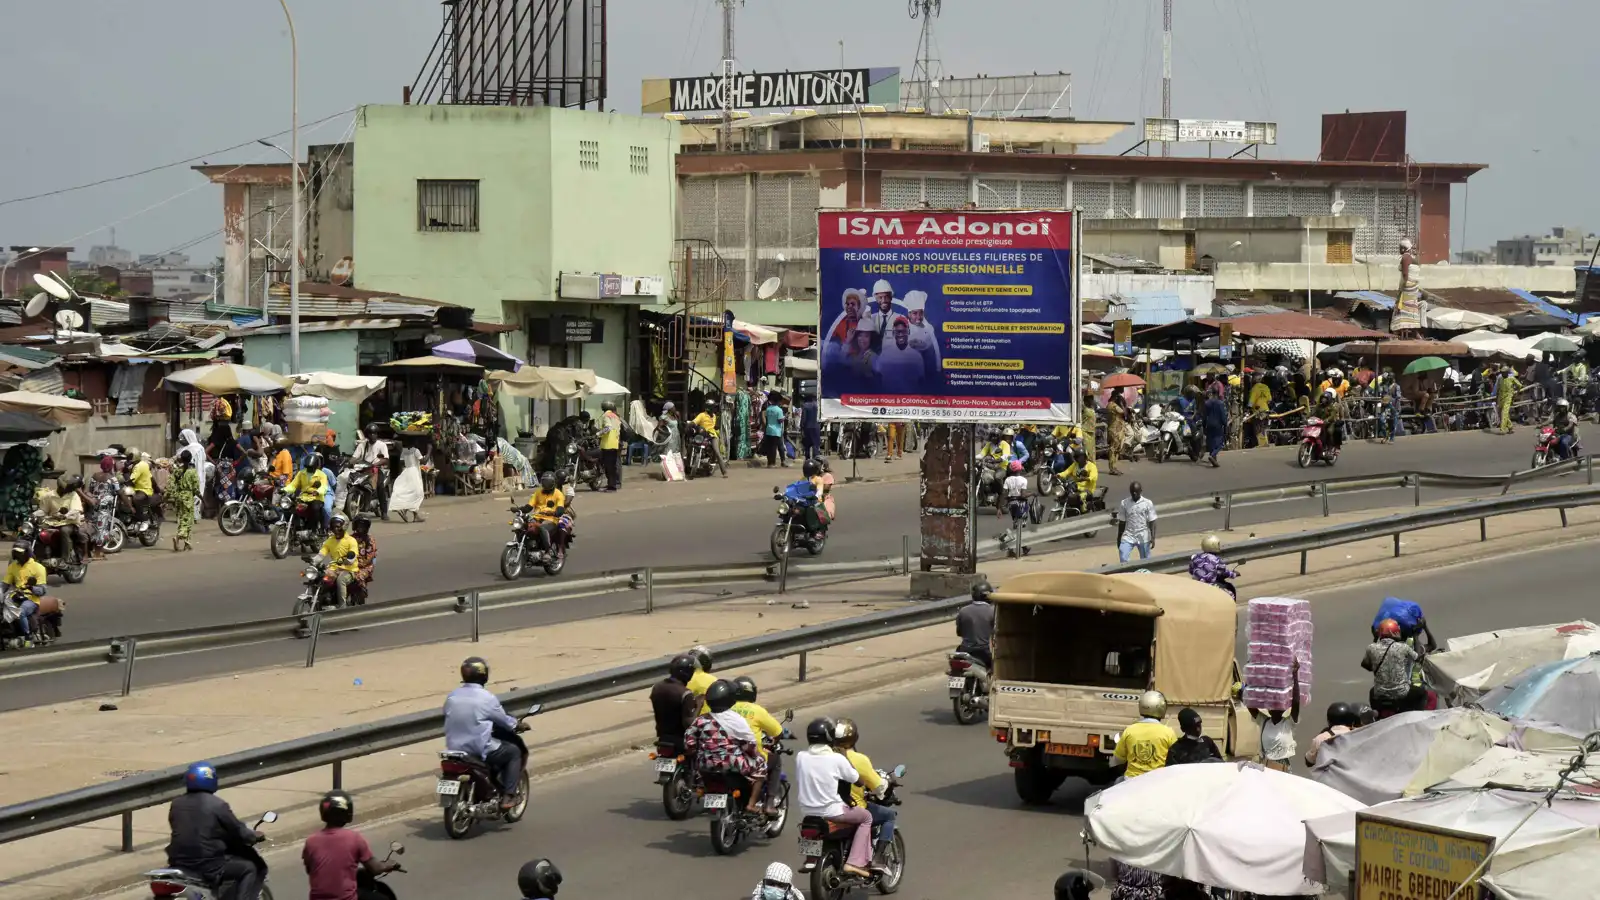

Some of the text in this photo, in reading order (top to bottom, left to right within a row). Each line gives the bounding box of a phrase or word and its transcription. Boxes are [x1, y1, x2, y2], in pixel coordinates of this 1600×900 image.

[675, 71, 865, 110] MARCHE DANTOKPA
[838, 216, 1052, 235] ISM Adonaï
[877, 237, 1013, 248] la marque d'une école prestigieuse
[844, 252, 1043, 262] REJOINDRE NOS NOUVELLES FILIERES DE
[862, 264, 1025, 274] LICENCE PROFESSIONNELLE
[975, 323, 1010, 331] HÔTELLERIE
[901, 397, 929, 405] Cotonou,
[930, 398, 951, 406] Calavi,
[952, 399, 990, 407] Porto-Novo,
[991, 399, 1017, 407] Parakou
[1362, 861, 1403, 892] MAIRIE
